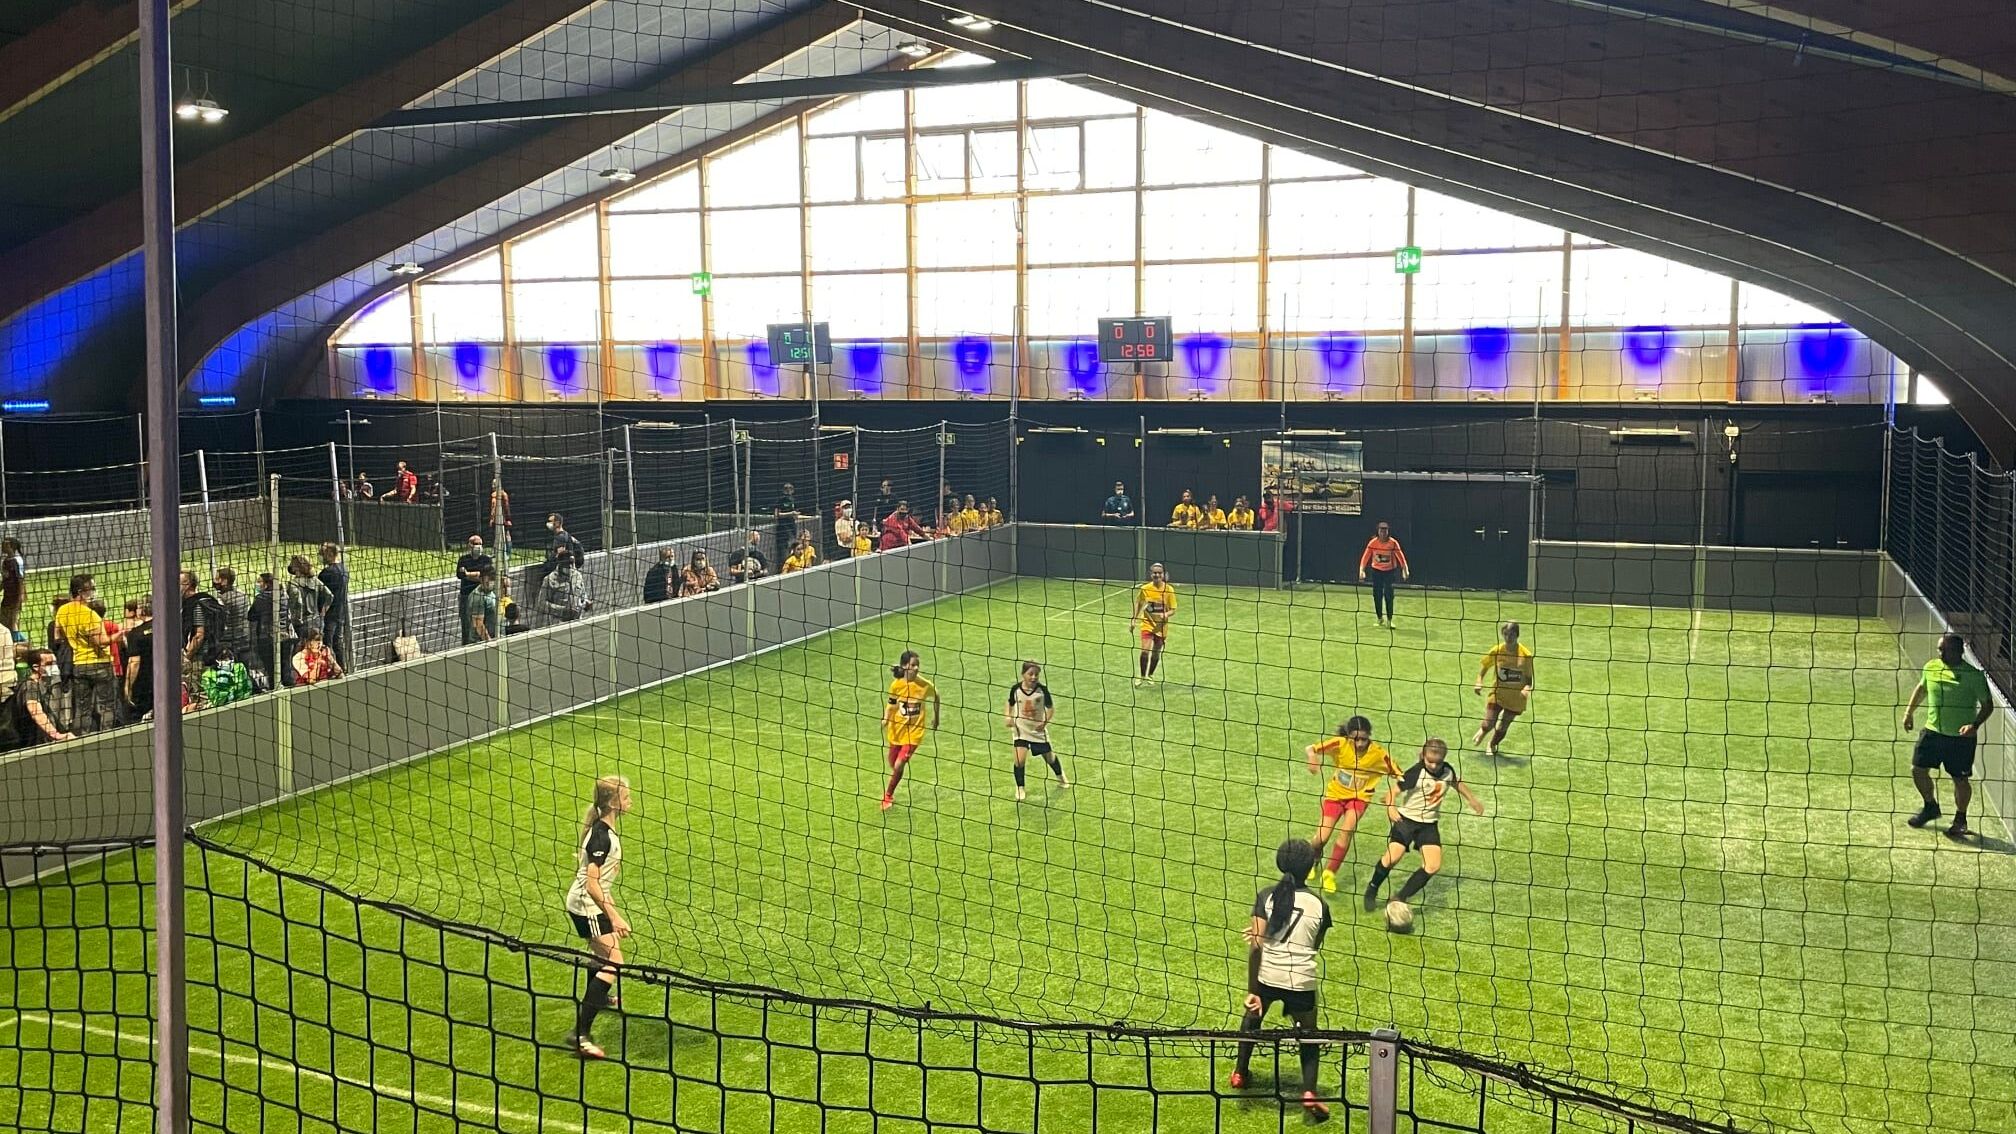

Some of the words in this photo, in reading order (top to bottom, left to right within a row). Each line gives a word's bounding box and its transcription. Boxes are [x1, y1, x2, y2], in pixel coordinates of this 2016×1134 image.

[1115, 327, 1124, 339] 0
[1146, 326, 1155, 338] 0
[1121, 344, 1155, 358] 12:58
[1280, 907, 1305, 943] 7
